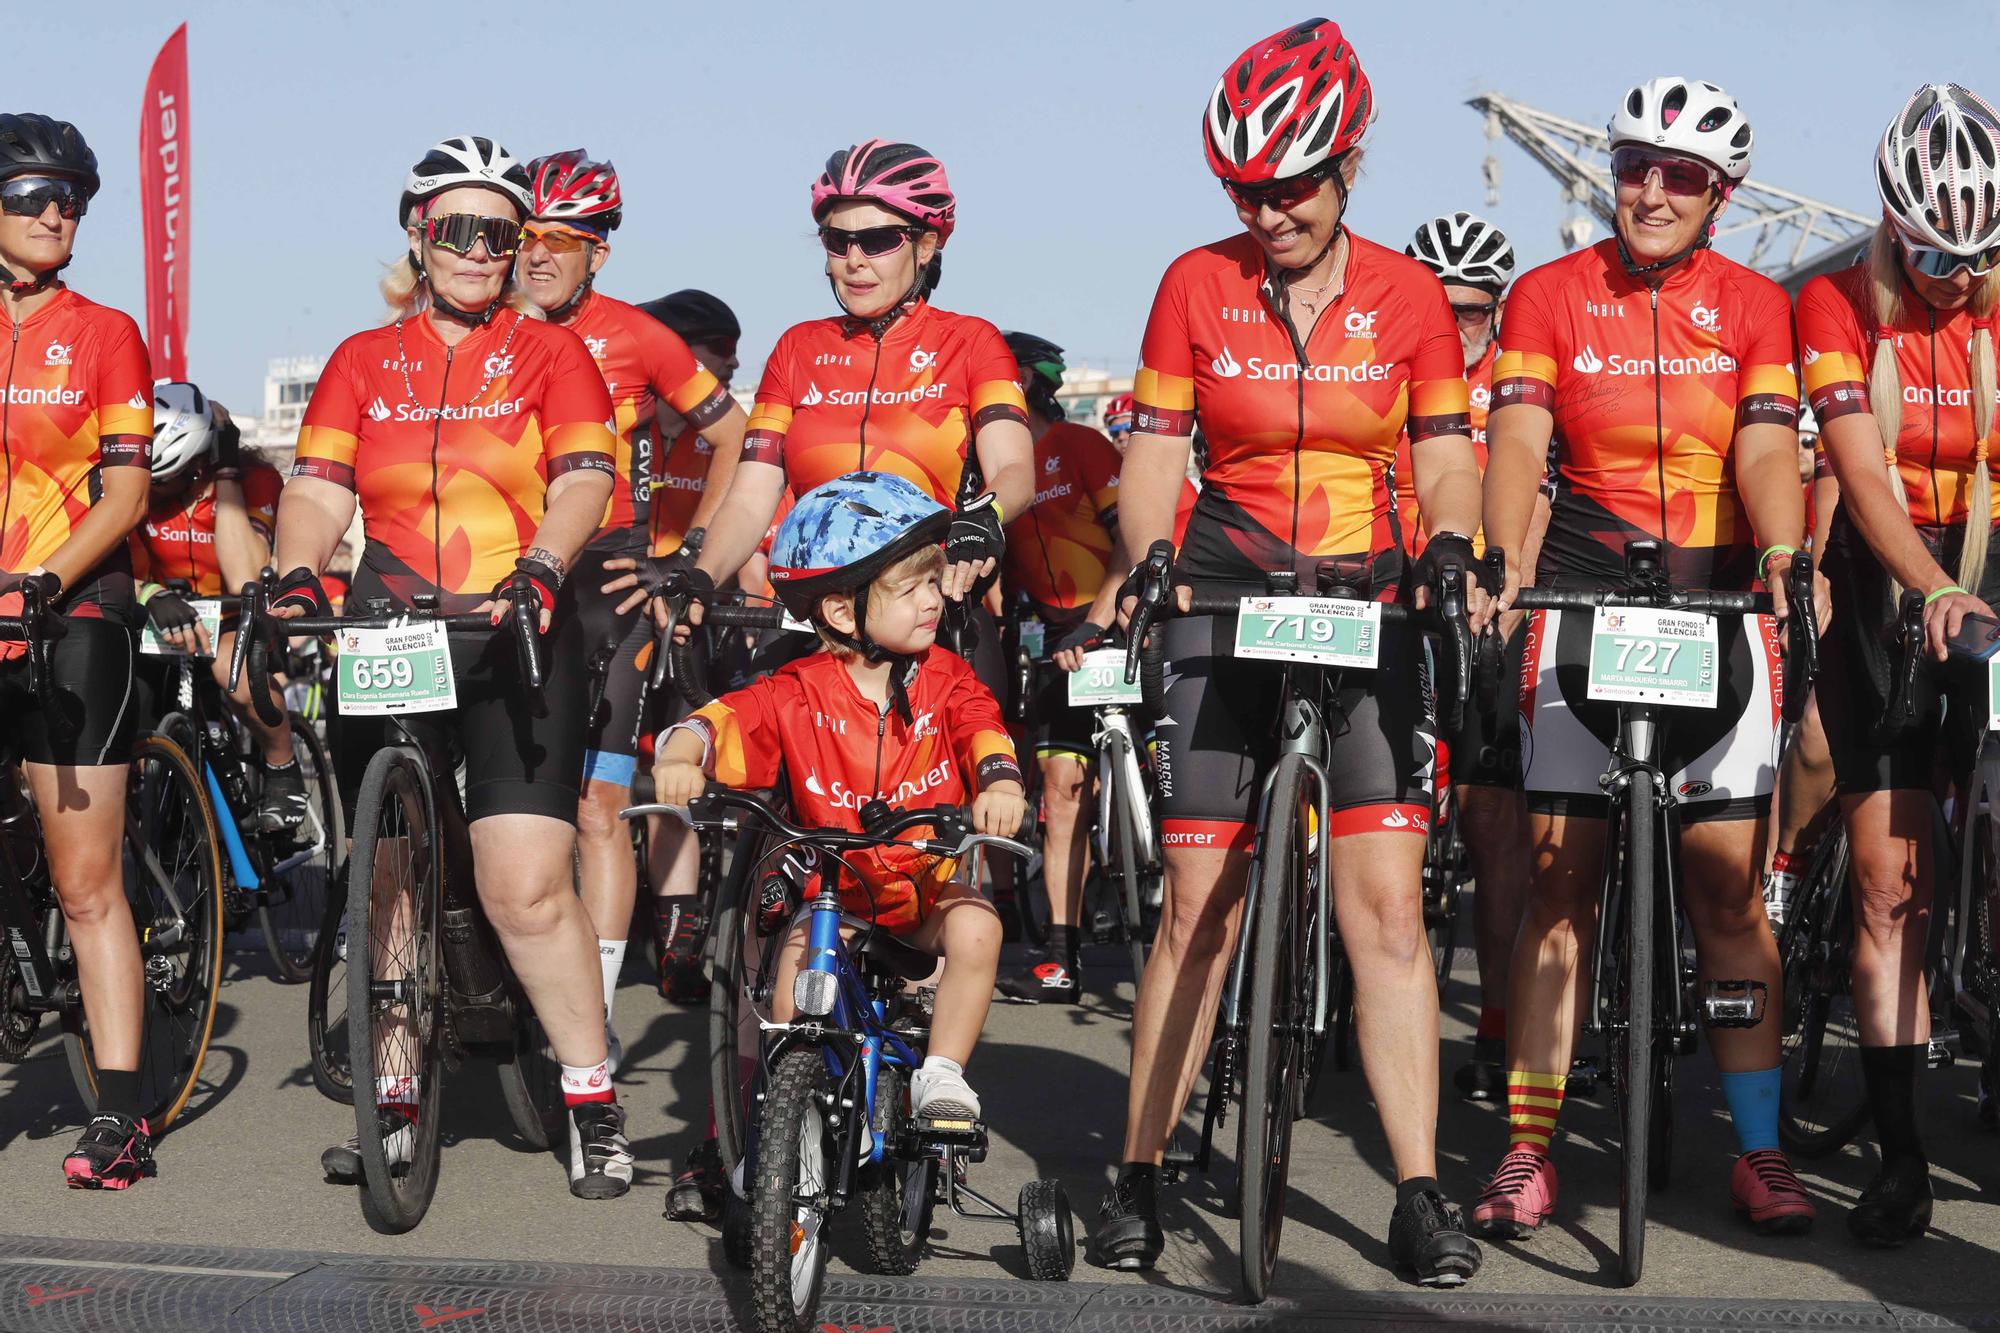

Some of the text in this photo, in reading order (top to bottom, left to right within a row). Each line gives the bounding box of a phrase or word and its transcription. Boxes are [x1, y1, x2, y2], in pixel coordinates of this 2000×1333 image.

[1222, 307, 1267, 324] GOBIK
[1586, 300, 1625, 318] GOBIK
[1344, 331, 1378, 339] VALENCIA
[1246, 357, 1394, 383] Santander
[825, 382, 948, 406] Santander
[394, 397, 524, 423] Santander
[1309, 602, 1330, 610] GRAN
[1331, 604, 1356, 612] FONDO
[1309, 608, 1355, 617] VALENCIA
[1262, 615, 1335, 643] 719
[1658, 618, 1676, 627] GRAN
[1677, 620, 1698, 630] FONDO
[1658, 627, 1698, 637] VALENCIA
[385, 636, 403, 645] GRAN
[404, 633, 426, 644] FONDO
[387, 641, 427, 652] VALENCIA
[1357, 625, 1372, 653] 76 km
[1613, 638, 1681, 675] 727
[352, 656, 414, 690] 659
[434, 655, 448, 692] 76 km
[1088, 667, 1115, 688] 30
[1700, 649, 1713, 687] 76 km
[1160, 740, 1173, 798] MARCHA
